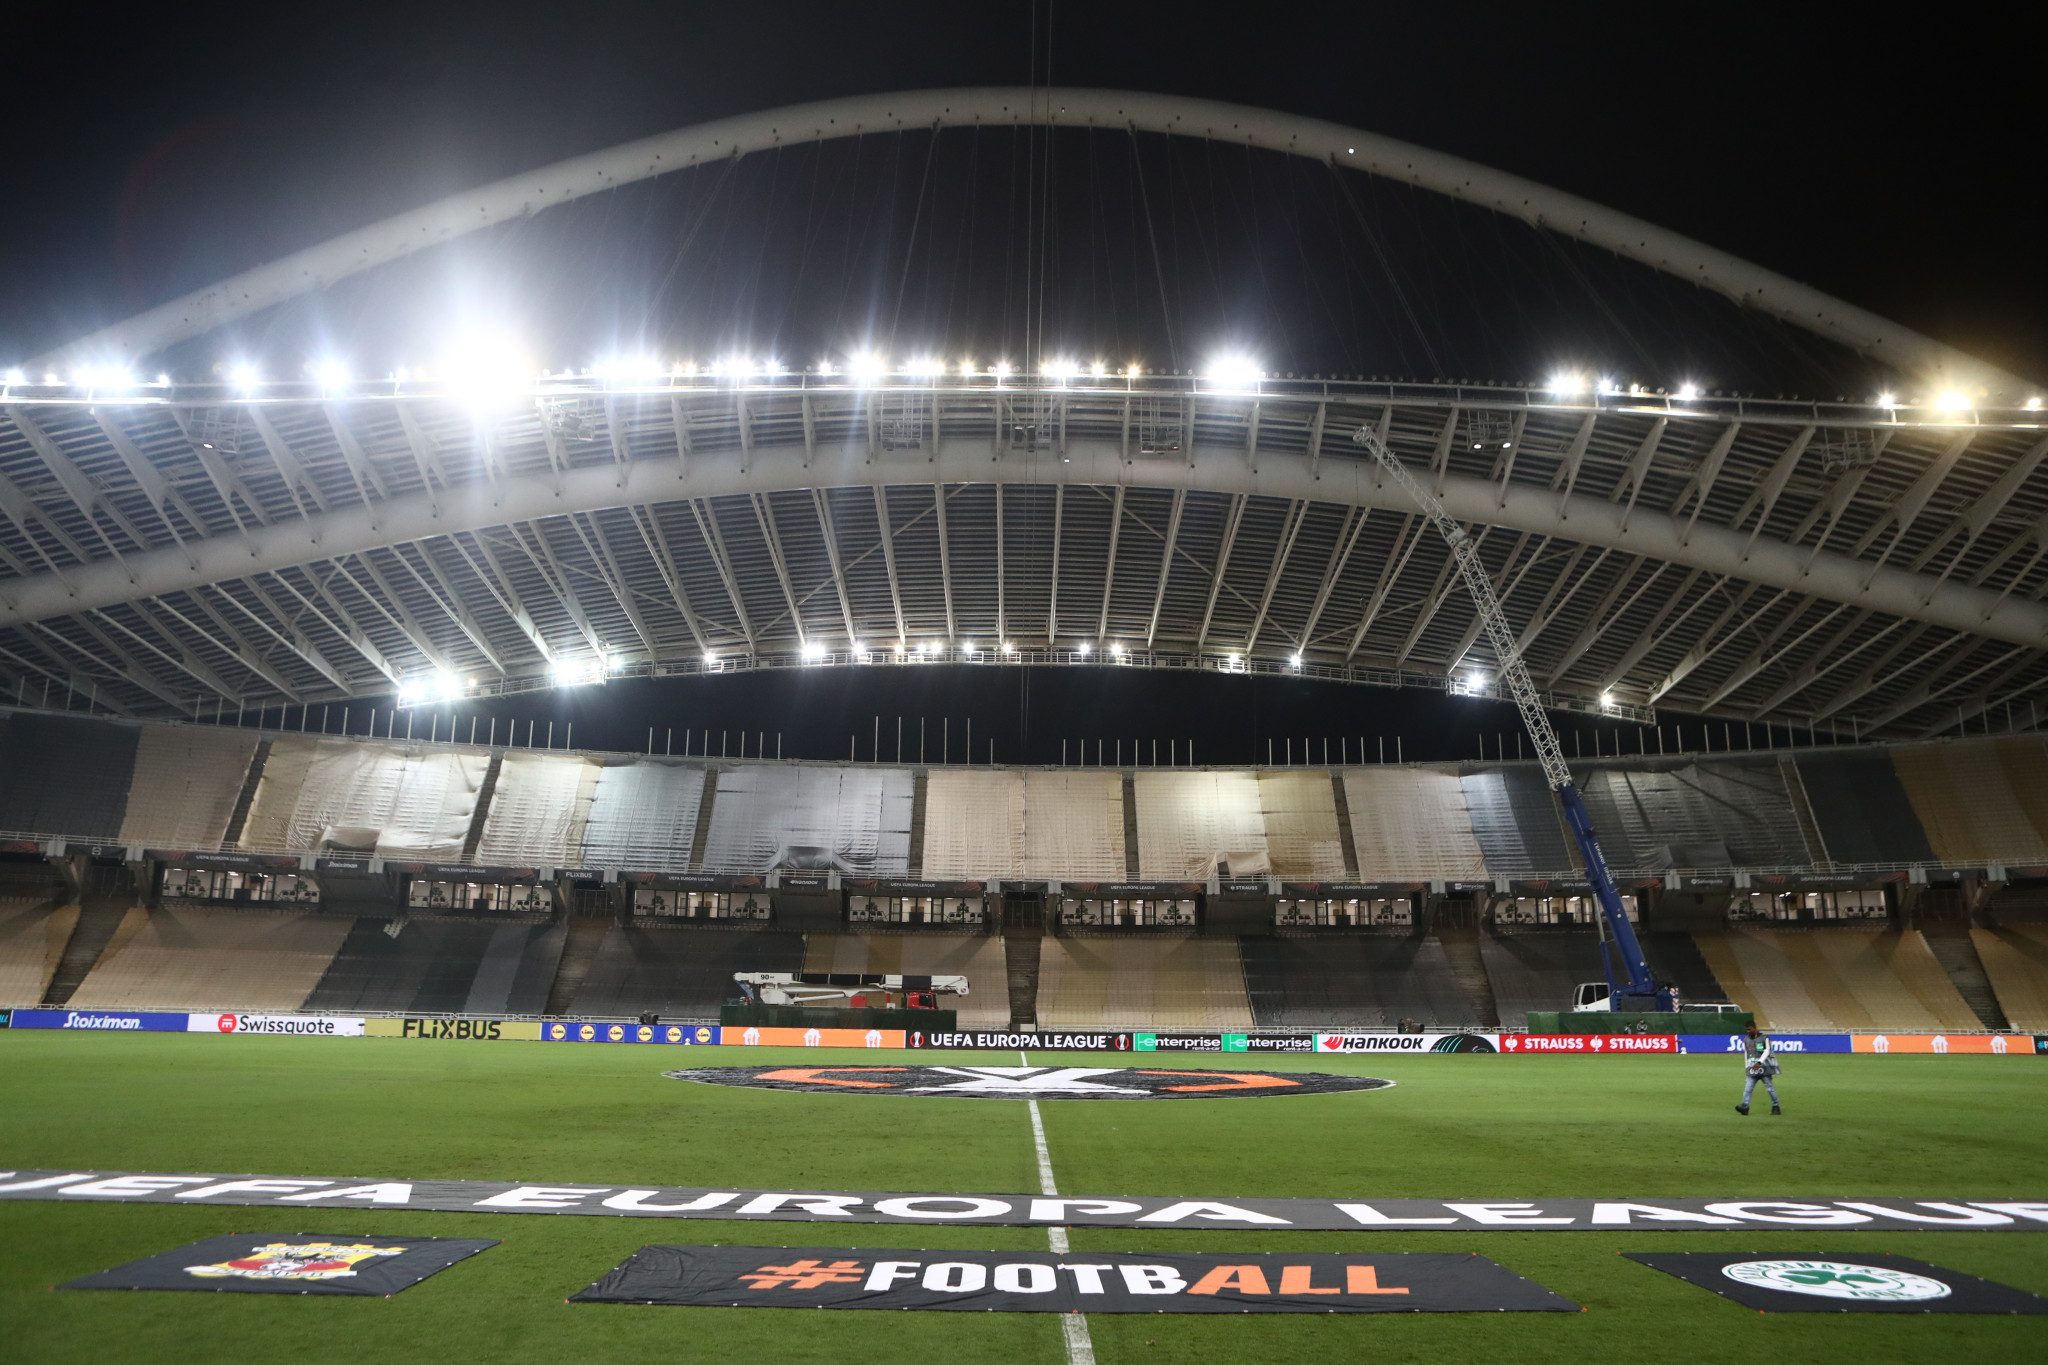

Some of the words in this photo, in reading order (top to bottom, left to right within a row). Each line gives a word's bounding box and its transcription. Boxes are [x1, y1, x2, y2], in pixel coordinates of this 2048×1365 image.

[63, 1012, 140, 1029] Stoiximan
[239, 1015, 335, 1034] Swissquote
[930, 1033, 973, 1047] UEFA
[977, 1034, 1039, 1047] EUROPA
[1045, 1035, 1107, 1048] LEAGUE
[1143, 1037, 1221, 1049] enterprise
[1235, 1037, 1312, 1050] enterprise
[1524, 1038, 1583, 1049] STRAUSS
[1609, 1038, 1668, 1049] STRAUSS
[473, 1187, 1293, 1224] EUROPA
[738, 1260, 1409, 1294] #FOOTBALL
